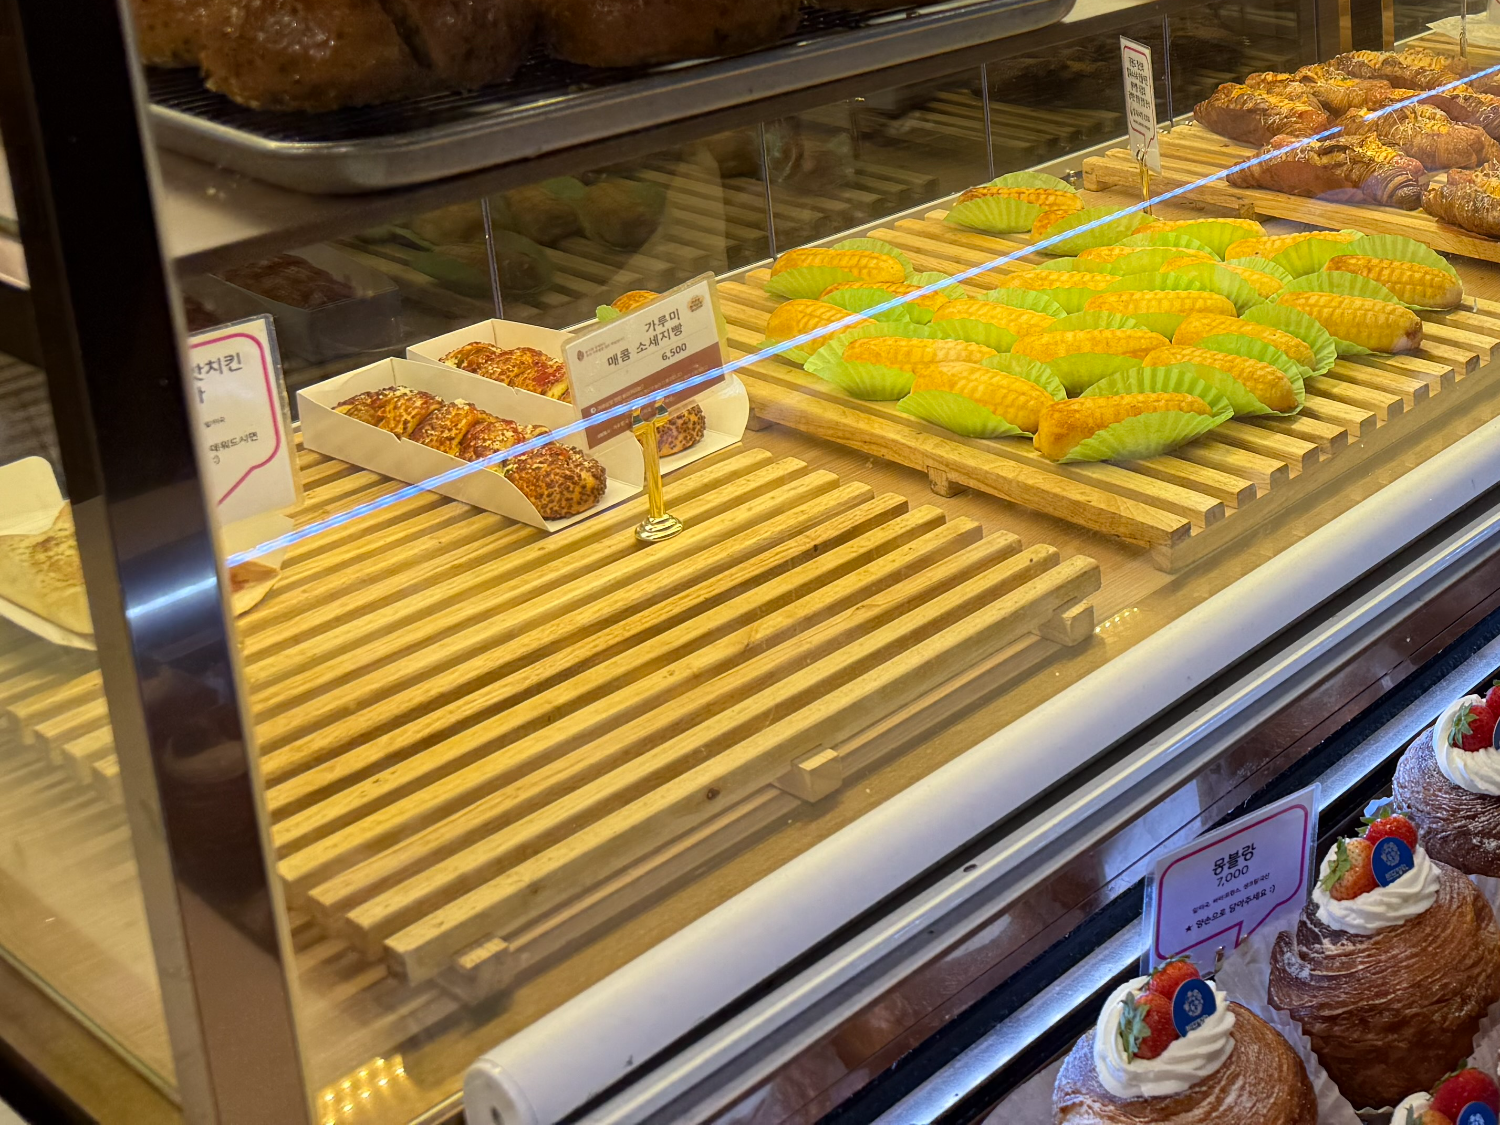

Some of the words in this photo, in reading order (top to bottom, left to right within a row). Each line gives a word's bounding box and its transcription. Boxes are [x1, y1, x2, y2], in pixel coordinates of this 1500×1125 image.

[644, 308, 681, 333] 가루미
[607, 348, 631, 367] 매콤
[636, 322, 683, 354] 소세지빵
[661, 342, 687, 361] 6,500
[1212, 842, 1257, 876] 몽블랑
[1216, 865, 1249, 888] 7,000
[1195, 907, 1226, 929] 양손으로
[1229, 889, 1267, 914] 담아주세요
